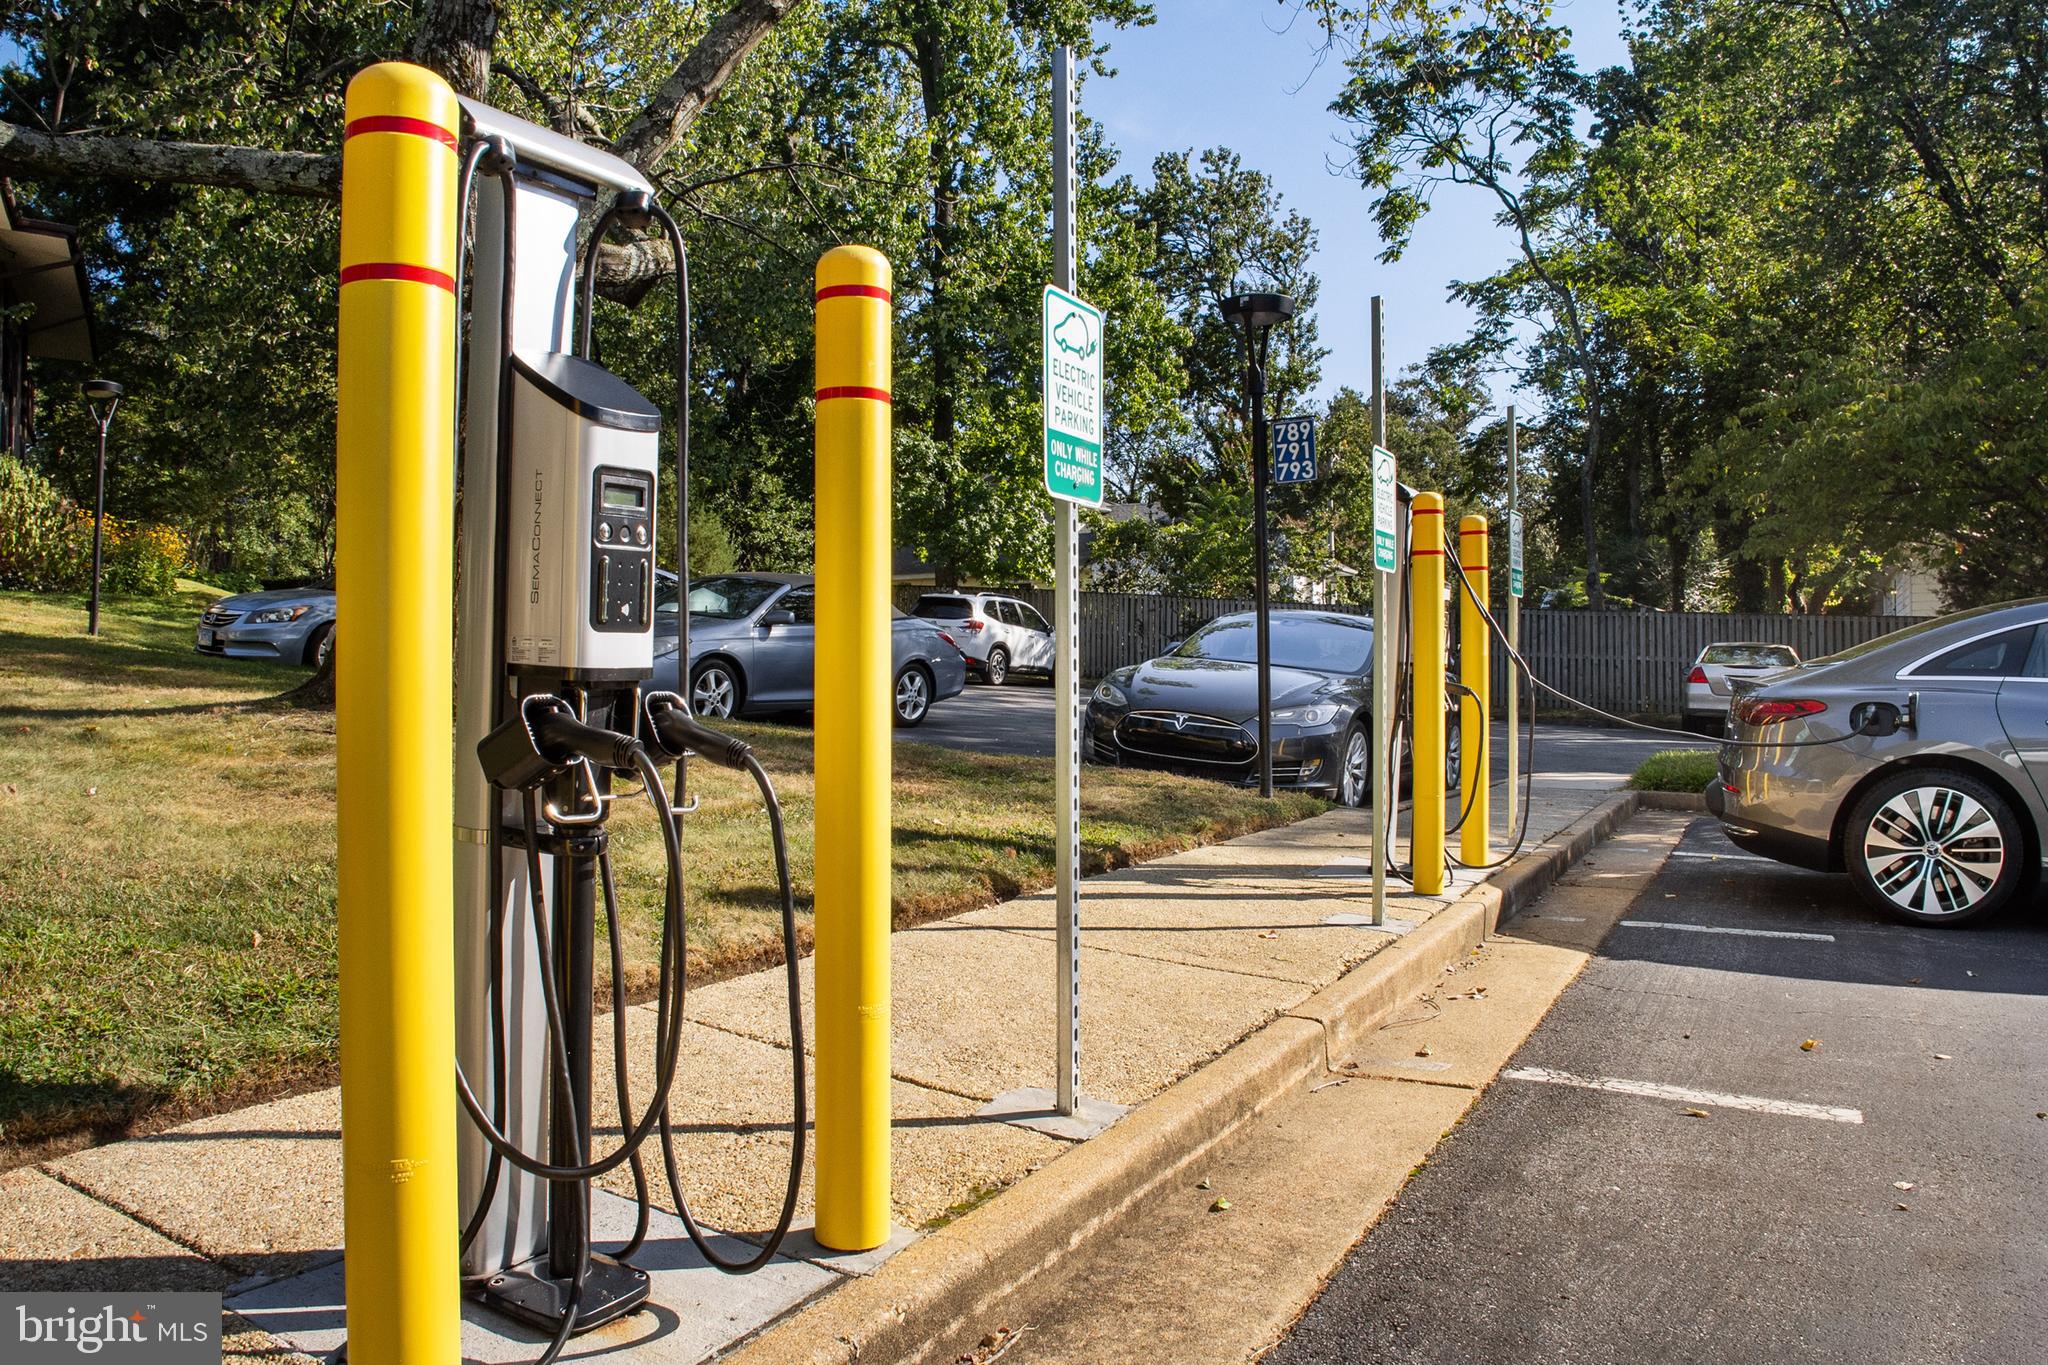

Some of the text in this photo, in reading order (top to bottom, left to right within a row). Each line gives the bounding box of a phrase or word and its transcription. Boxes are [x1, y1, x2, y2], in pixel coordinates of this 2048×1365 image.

[1053, 358, 1095, 391] ELECTRIC
[1056, 382, 1094, 413] VEHICLE
[1055, 406, 1094, 435] PARKING
[1275, 421, 1310, 442] 789
[1050, 438, 1098, 468] ONLY WHILE
[1276, 441, 1310, 461] 791
[1054, 460, 1095, 486] CHARGING
[1277, 460, 1314, 480] 793
